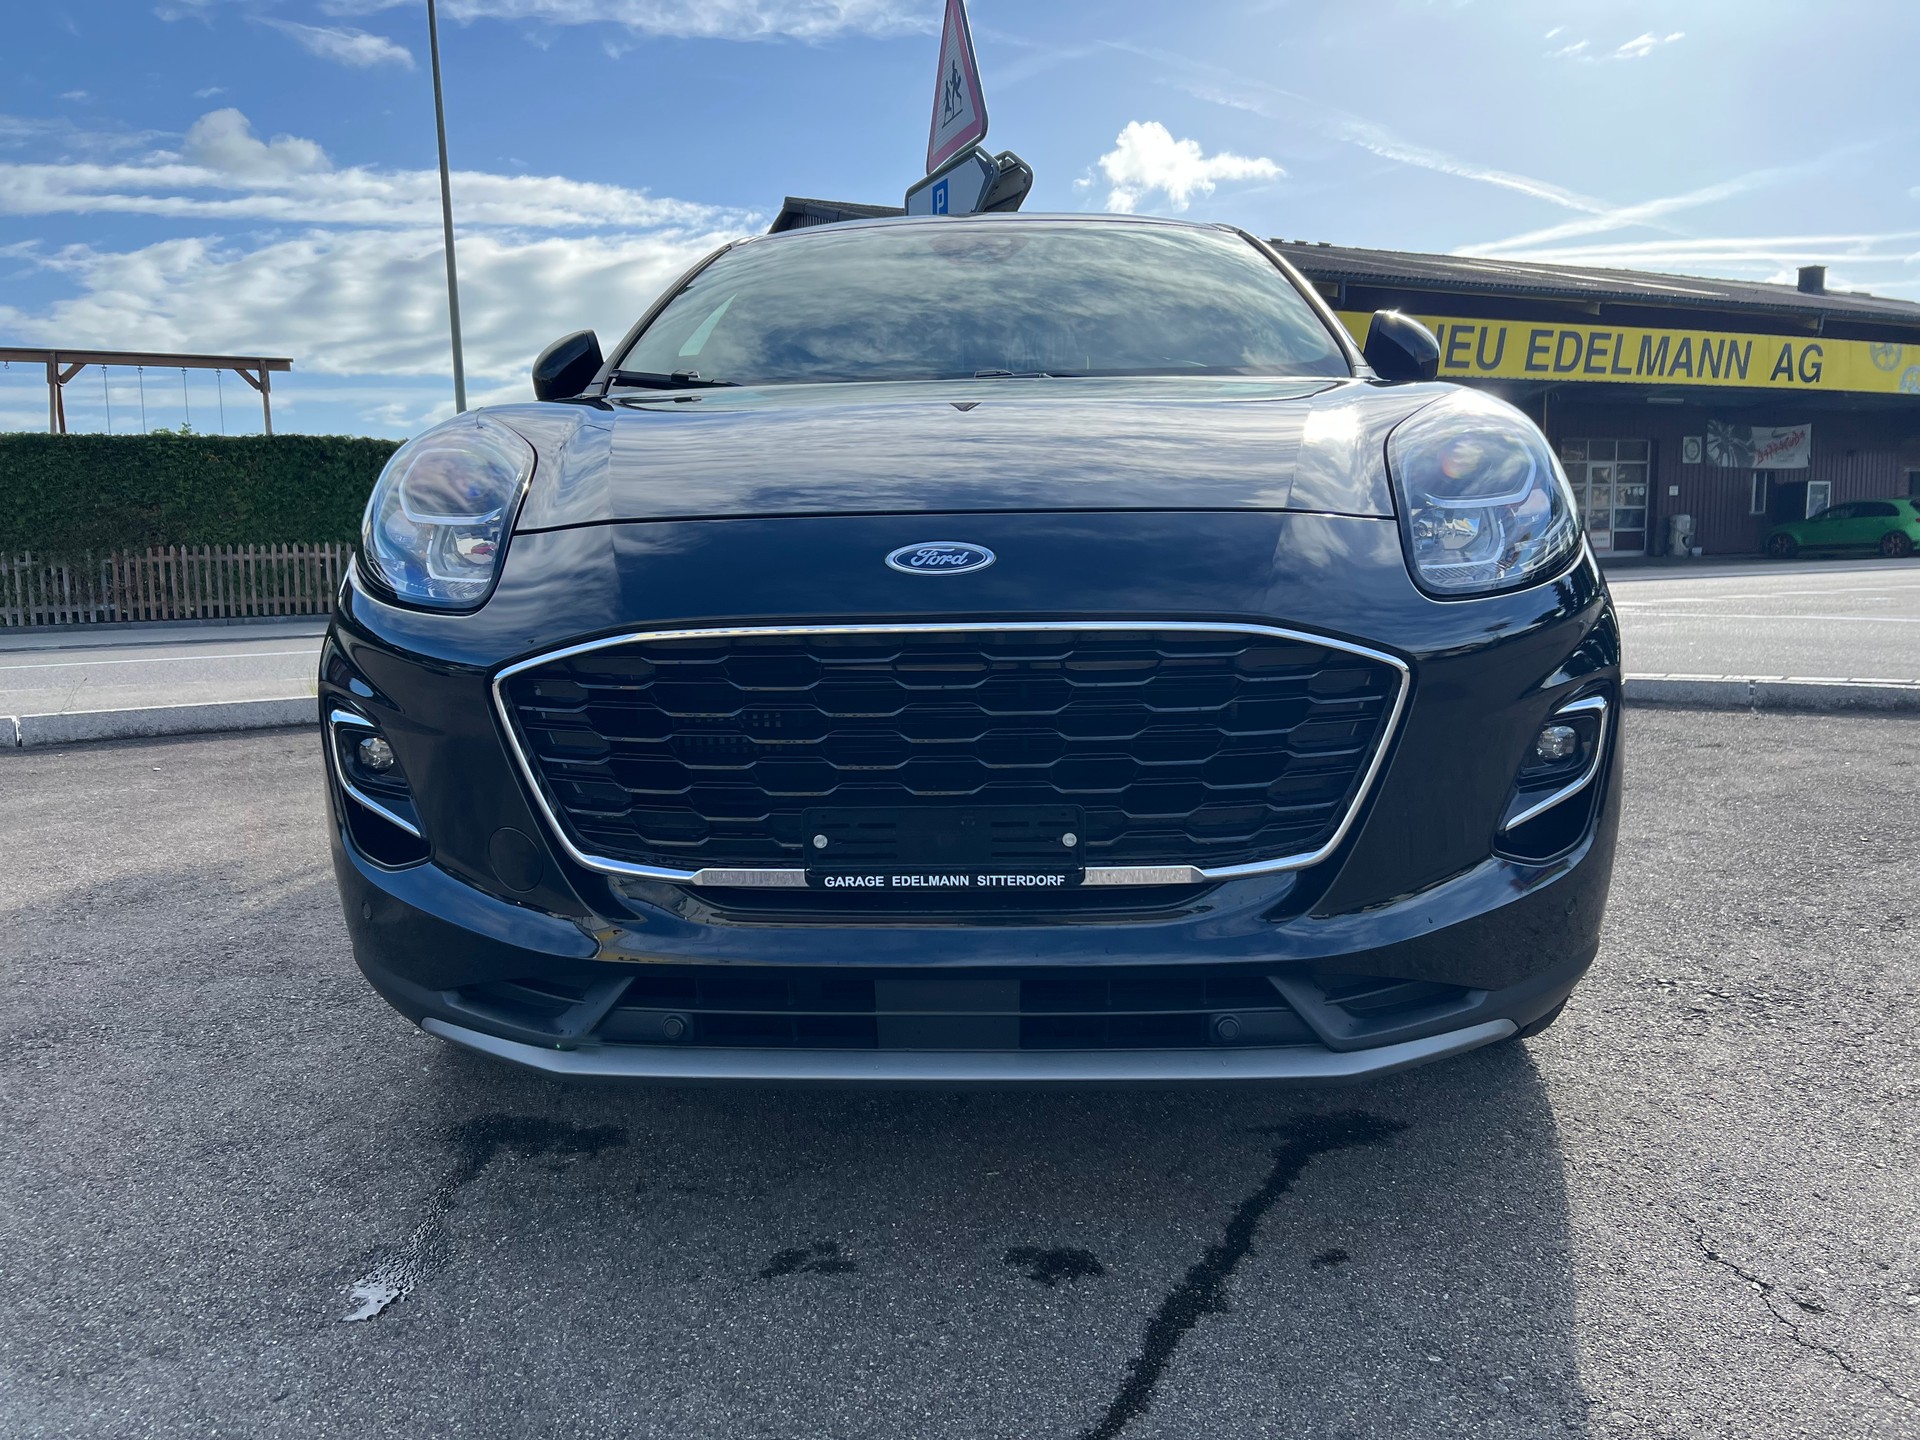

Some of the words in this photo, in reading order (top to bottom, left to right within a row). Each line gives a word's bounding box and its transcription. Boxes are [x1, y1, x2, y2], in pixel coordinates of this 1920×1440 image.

[936, 188, 945, 215] P
[1524, 328, 1753, 380] EDELMANN
[1769, 342, 1824, 383] AG
[910, 548, 969, 566] Ford
[824, 876, 885, 888] GARAGE
[892, 875, 970, 887] EDELMANN
[977, 874, 1066, 886] SITTERDORF
